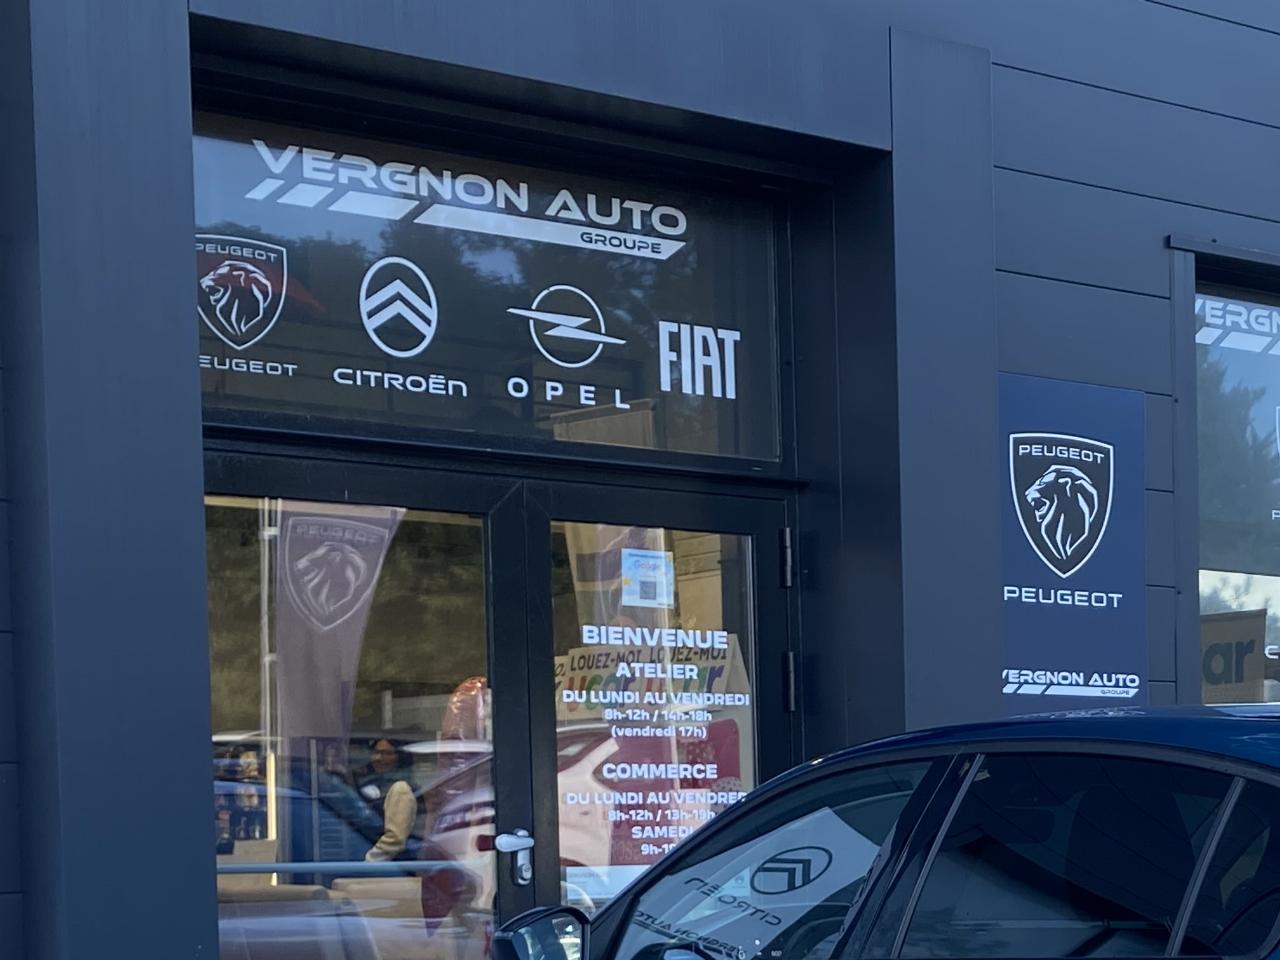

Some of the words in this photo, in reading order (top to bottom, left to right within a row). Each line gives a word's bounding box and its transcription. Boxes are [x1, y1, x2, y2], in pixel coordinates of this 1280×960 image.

[252, 139, 528, 212] VERGNON
[544, 189, 687, 236] AUTO
[580, 231, 662, 254] GROUPE
[199, 355, 298, 376] EUGEOT
[658, 320, 741, 399] FIAT
[507, 377, 631, 410] OPEL
[1018, 445, 1105, 463] PEUGEOT
[1003, 586, 1123, 608] PEUGEOT
[582, 624, 728, 649] BIENVENUE
[615, 662, 699, 679] ATELIER
[1203, 639, 1256, 686] ar
[1088, 673, 1140, 687] AUTO
[562, 690, 587, 703] DU
[590, 690, 640, 704] LUNDI
[643, 692, 667, 704] AU
[670, 692, 750, 706] VENDREDI
[603, 709, 650, 721] 8h-12h
[611, 725, 676, 738] (vendredi
[678, 726, 707, 739] 17h)
[602, 763, 718, 779] COMMERCE
[566, 791, 591, 805] DU
[594, 791, 643, 805] LUNDI
[647, 791, 670, 805] AU
[607, 809, 654, 821] 8h-12h
